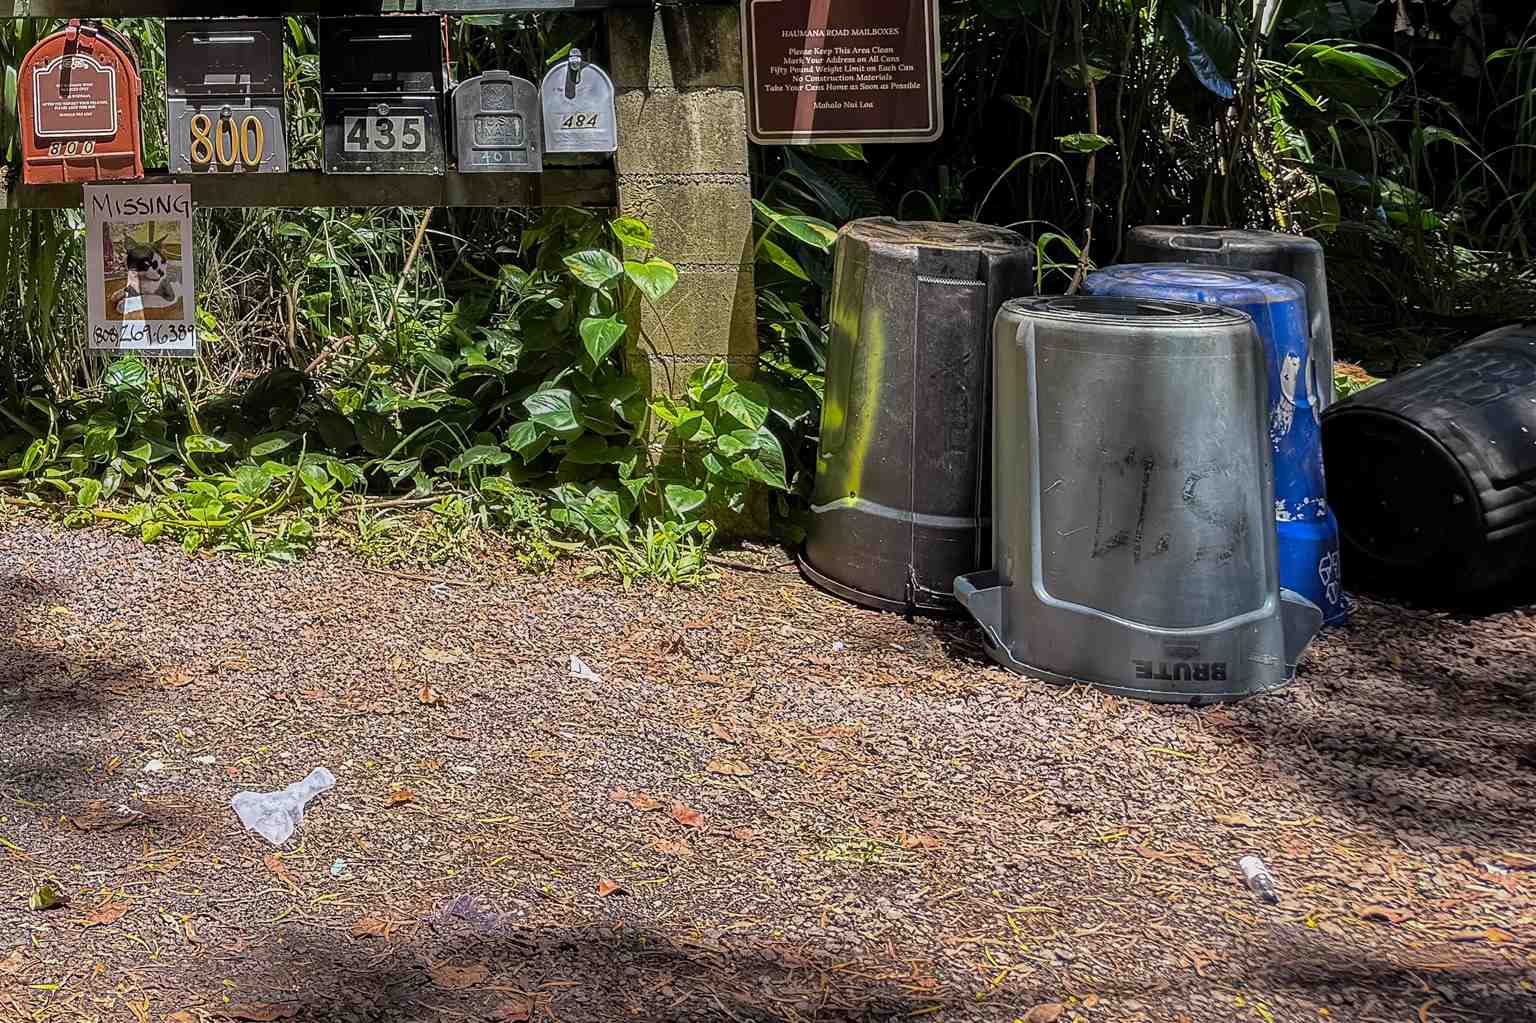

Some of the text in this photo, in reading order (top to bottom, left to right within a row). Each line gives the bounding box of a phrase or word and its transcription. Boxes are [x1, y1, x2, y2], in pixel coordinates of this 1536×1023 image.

[782, 28, 899, 37] HAUMANA ROAD MAILBOXES
[789, 47, 812, 55] Please
[814, 47, 832, 57] Keep
[872, 46, 894, 54] Clean
[826, 56, 855, 64] Address
[770, 66, 787, 75] Fifty
[816, 65, 842, 74] Weight
[879, 64, 897, 72] Each
[805, 74, 854, 82] Construction
[856, 73, 892, 81] Materials
[765, 84, 784, 92] Take
[805, 83, 824, 91] Cans
[860, 82, 879, 90] Soon
[563, 114, 598, 127] 484
[191, 114, 264, 166] 800
[347, 118, 422, 150] 435
[51, 142, 93, 155] 800
[92, 193, 190, 219] MISSING
[1132, 660, 1227, 682] BRUTE
